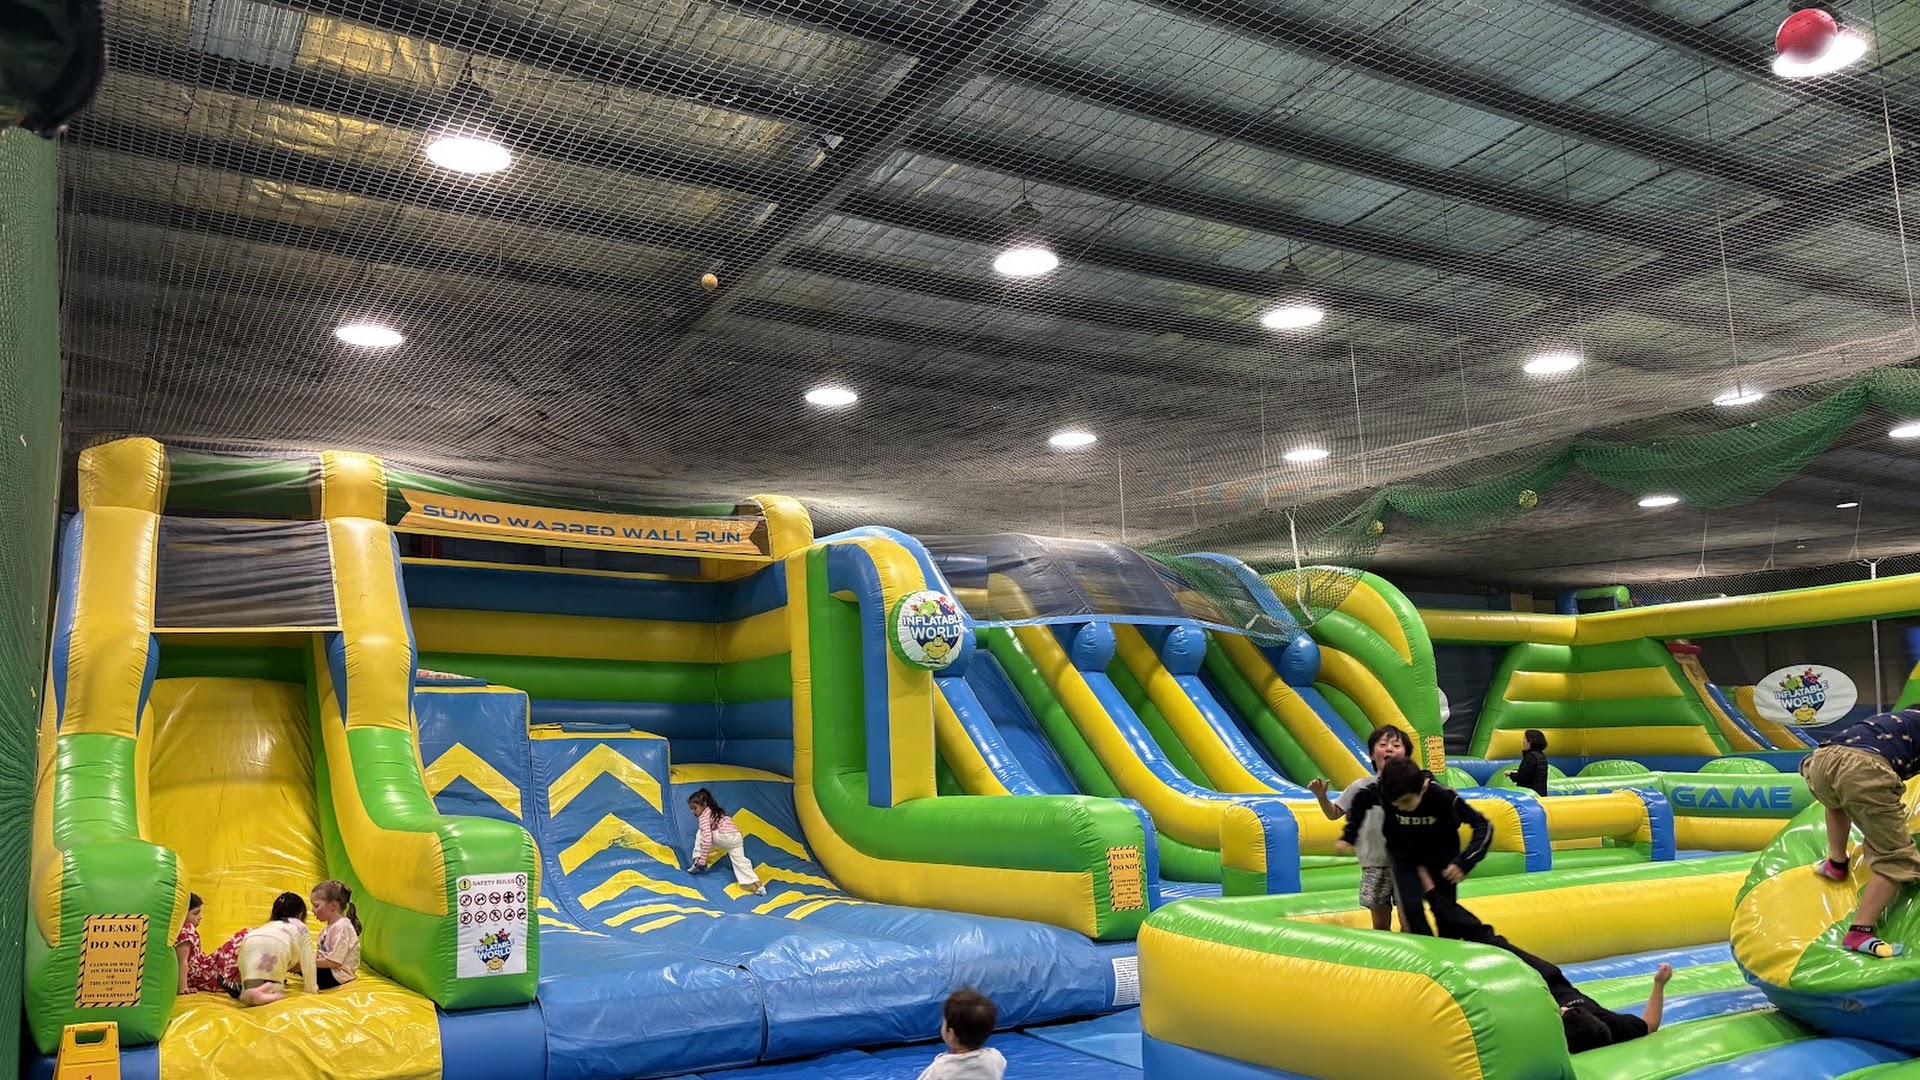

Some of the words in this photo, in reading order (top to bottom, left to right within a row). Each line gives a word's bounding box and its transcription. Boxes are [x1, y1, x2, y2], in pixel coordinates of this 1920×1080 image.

[422, 504, 501, 525] SUMO
[507, 516, 616, 537] WARPED
[622, 527, 688, 542] WALL
[695, 530, 741, 543] RUN
[902, 614, 963, 626] INFLATABLE
[910, 625, 961, 640] WORLD
[1773, 680, 1830, 700] INFLATABLE
[1781, 692, 1825, 709] WORLD
[1671, 786, 1793, 809] GAME
[93, 924, 139, 933] PLEASE
[90, 941, 109, 949] DO
[112, 940, 139, 949] NOT
[473, 938, 515, 952] INFLATABLE
[480, 946, 511, 959] WORLD
